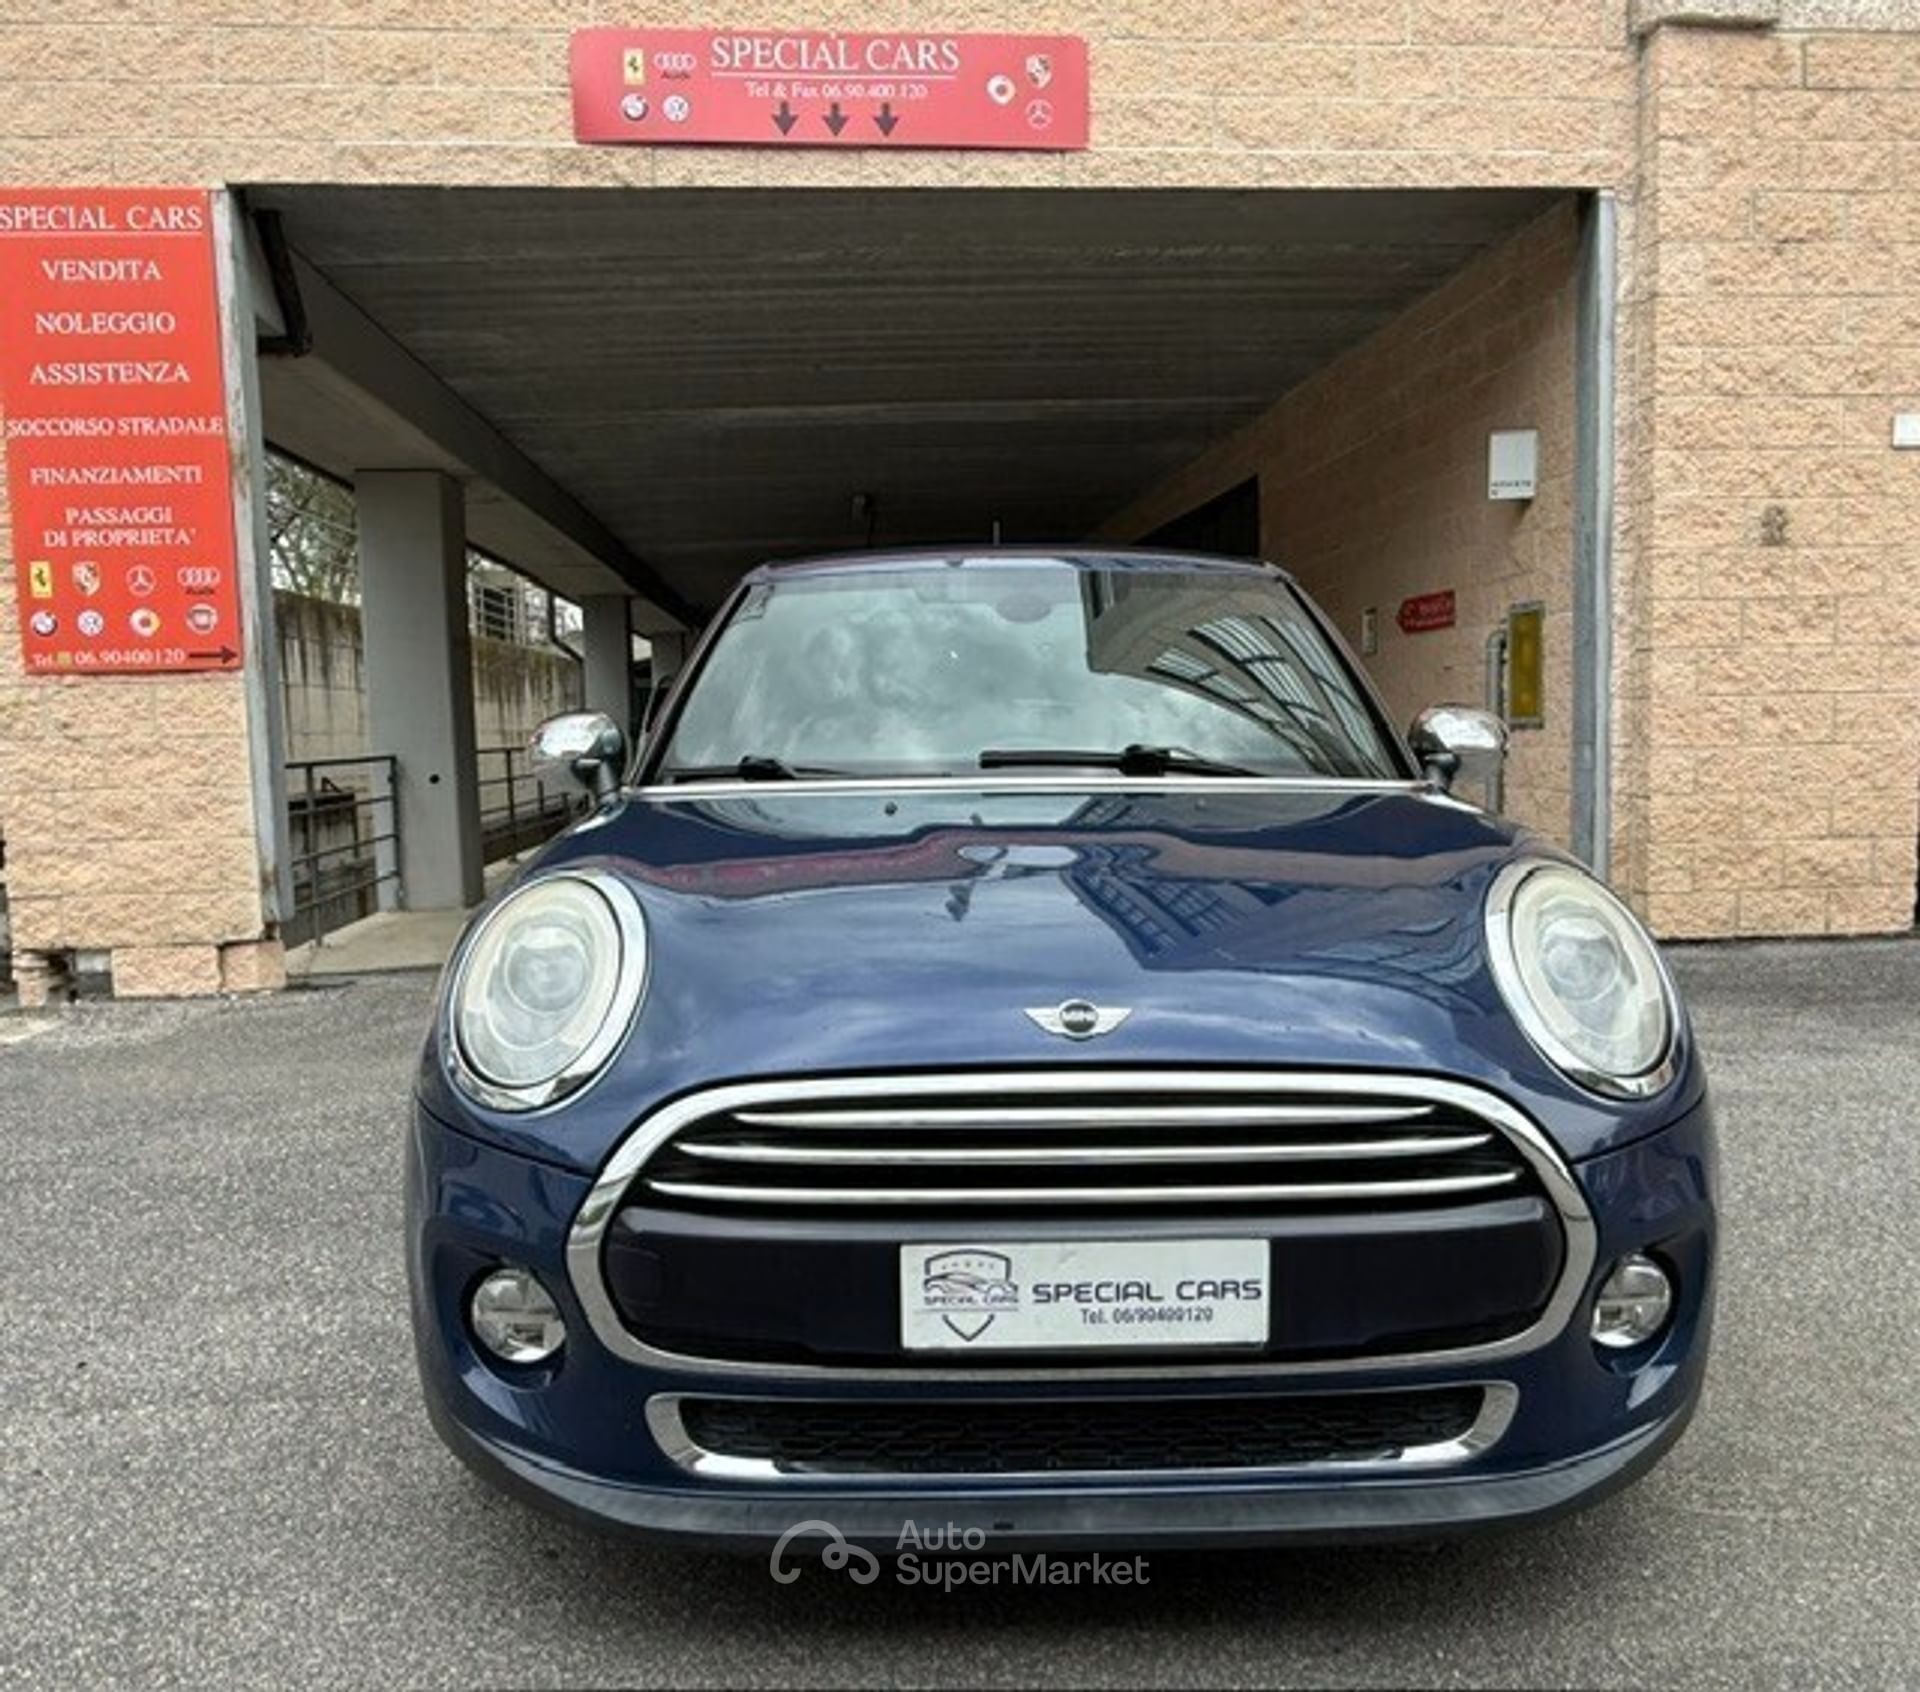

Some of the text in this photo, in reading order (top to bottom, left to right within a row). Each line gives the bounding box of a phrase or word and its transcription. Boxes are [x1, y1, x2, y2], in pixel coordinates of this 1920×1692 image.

[711, 37, 960, 71] SPECIAL CARS
[745, 81, 769, 97] Tel
[773, 82, 787, 97] &
[792, 81, 818, 98] Fax
[0, 206, 203, 230] SPECIAL CARS
[41, 260, 163, 281] VENDITA
[35, 312, 176, 335] NOLEGGIO
[30, 362, 191, 385] ASSISTENZA
[8, 417, 224, 437] SOCCORSO STRADALE
[30, 465, 203, 485] FINANZIAMENTI
[65, 507, 173, 525] PASSAGGI
[44, 531, 67, 547] DI
[1032, 1281, 1262, 1304] SPECIAL CARS
[1080, 1308, 1109, 1325] Tel.
